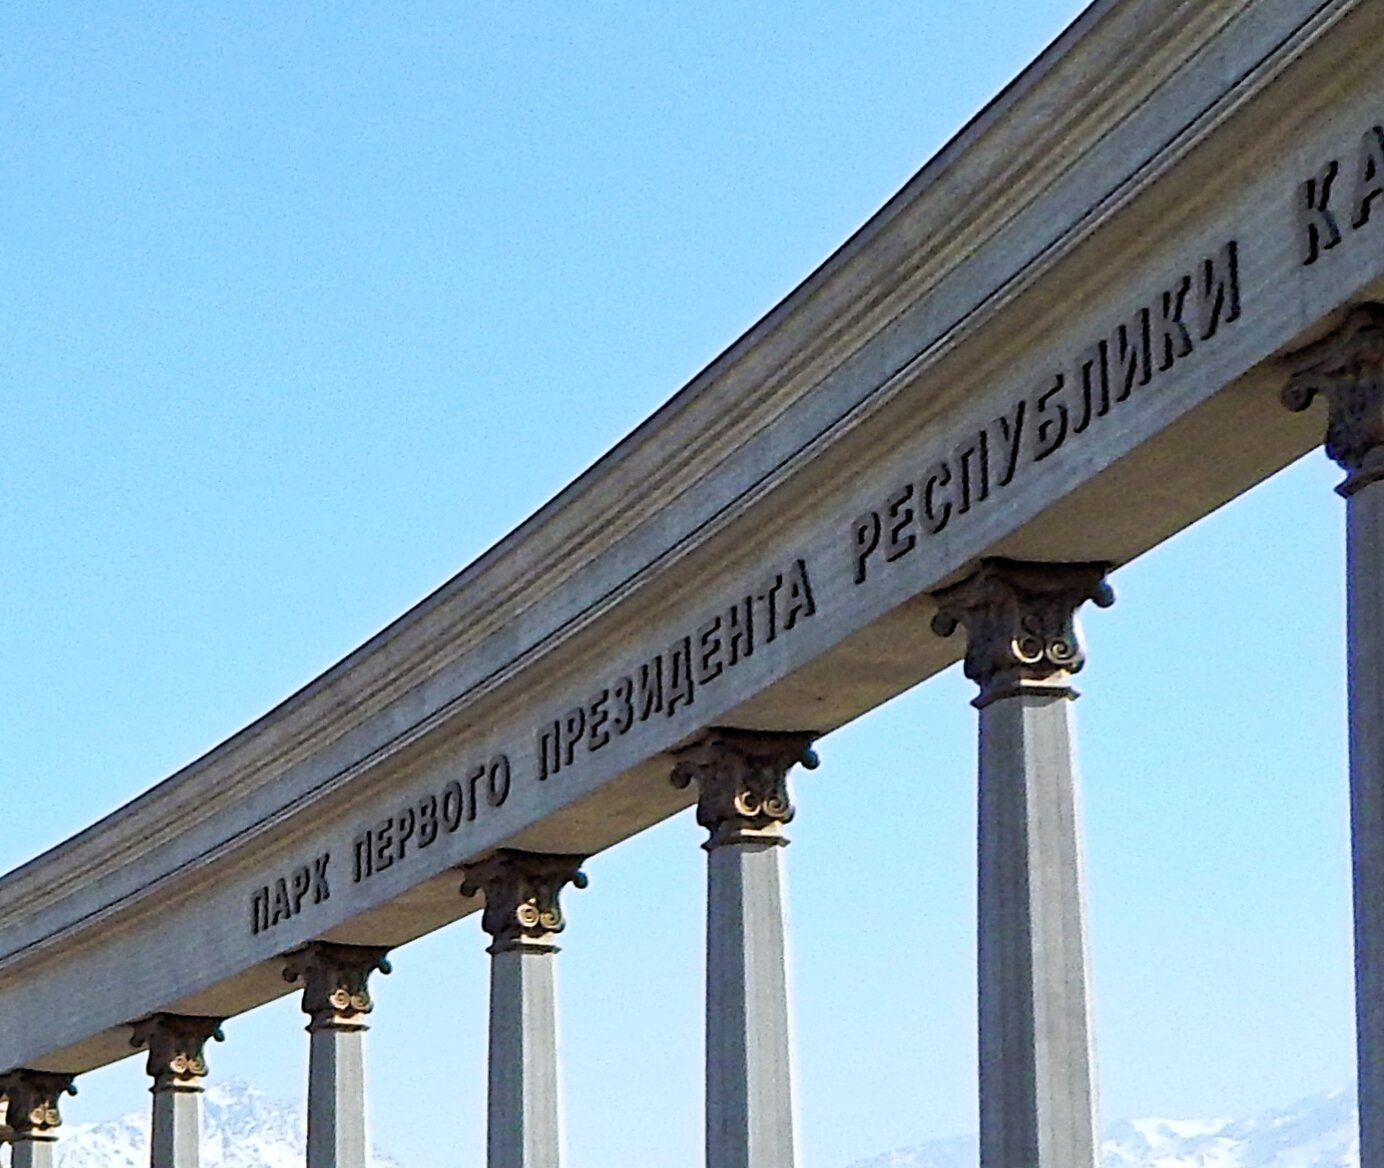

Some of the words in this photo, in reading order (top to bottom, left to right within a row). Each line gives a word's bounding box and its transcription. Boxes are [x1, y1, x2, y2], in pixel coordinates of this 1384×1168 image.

[250, 853, 331, 936] ПАРК
[351, 753, 512, 884] ПЕРВОГО
[536, 557, 816, 782] ПРЕЗИДЕНТА
[850, 239, 1241, 585] РЕСПУБЛИКИ
